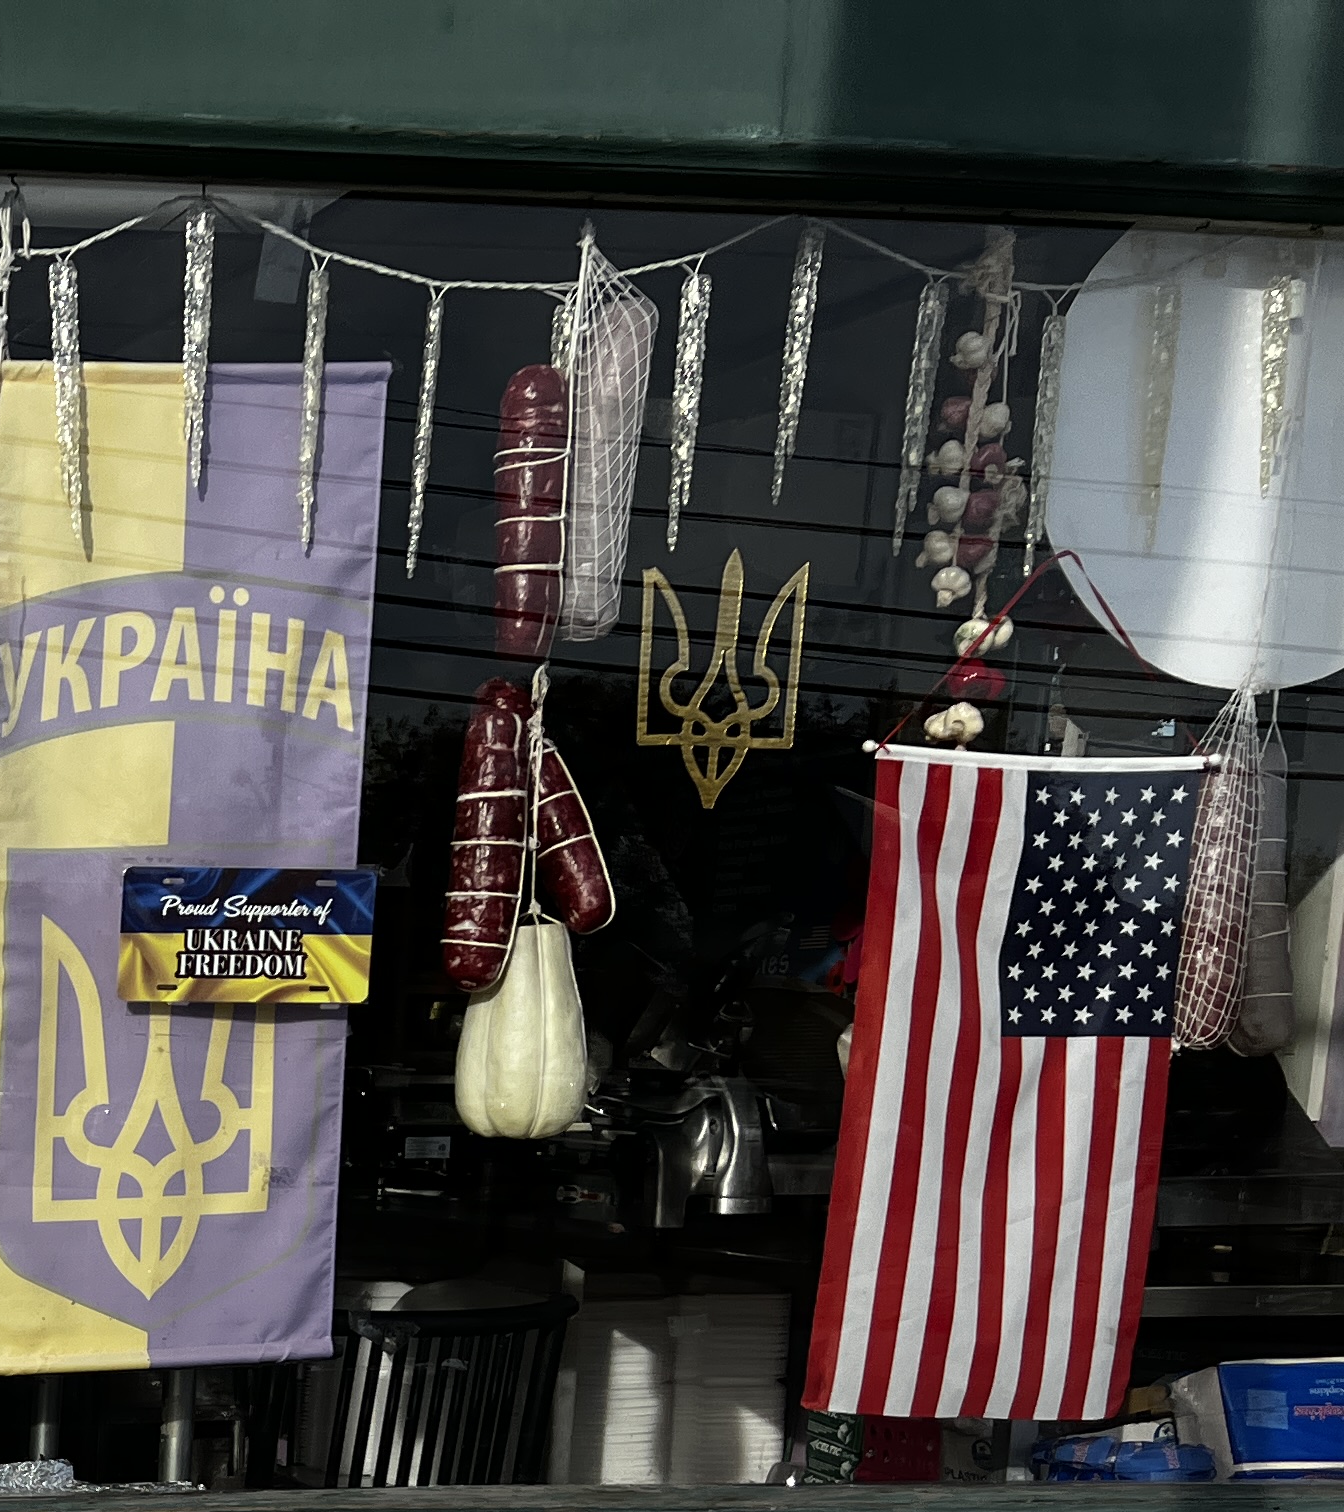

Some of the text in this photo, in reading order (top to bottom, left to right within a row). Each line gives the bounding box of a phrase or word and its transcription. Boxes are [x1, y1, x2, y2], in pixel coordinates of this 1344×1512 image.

[0, 585, 355, 738] УКРАЇНА
[159, 894, 333, 926] Proud Supporter of
[185, 928, 301, 952] UKRAINE
[178, 953, 305, 977] FREEDOM
